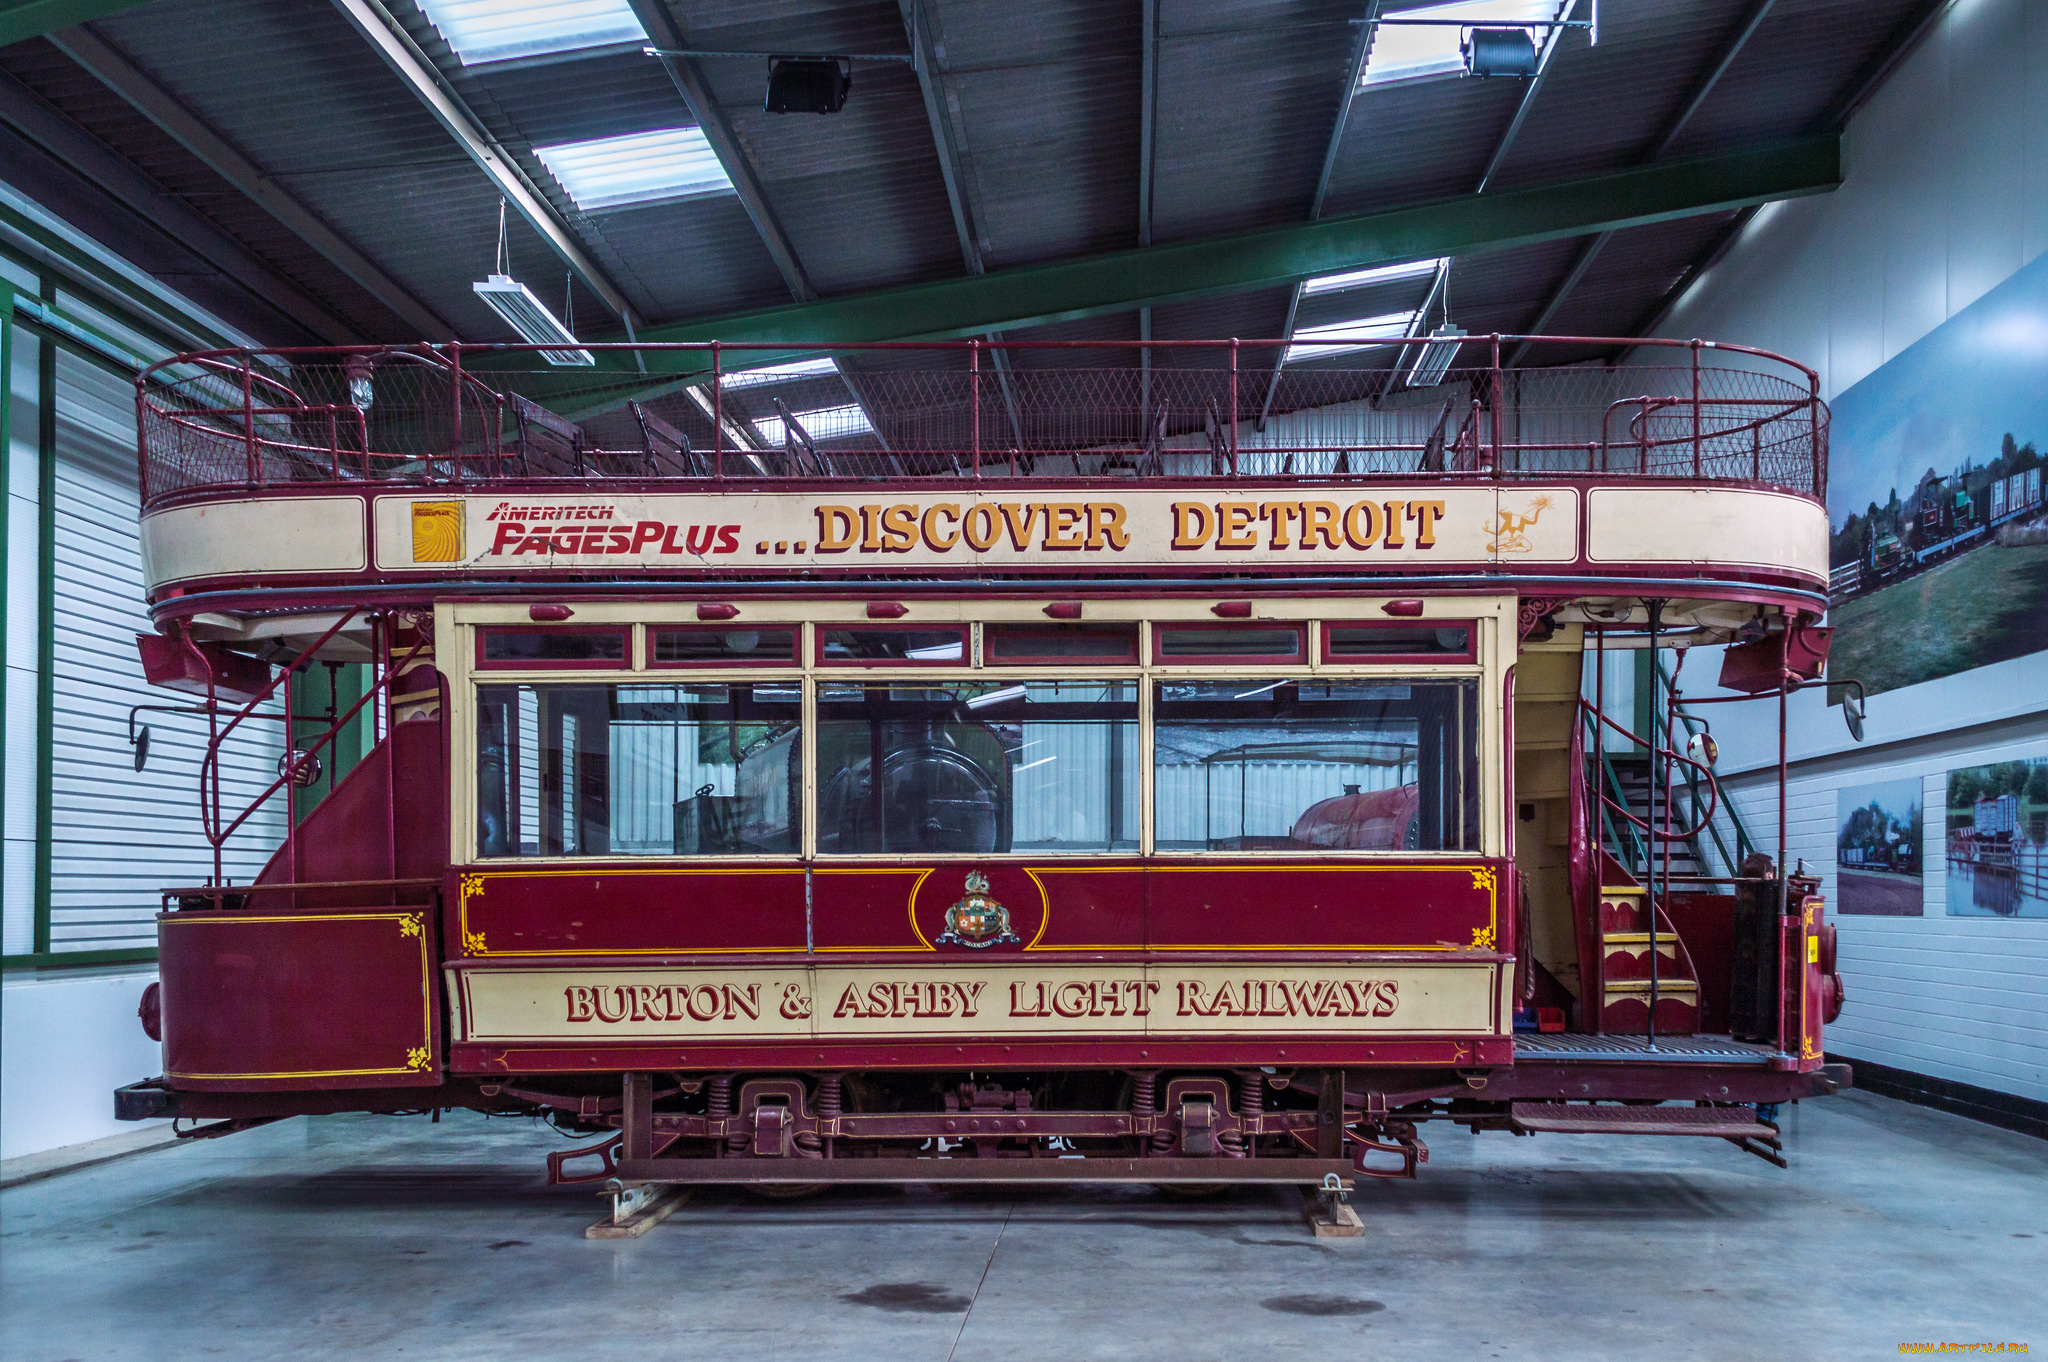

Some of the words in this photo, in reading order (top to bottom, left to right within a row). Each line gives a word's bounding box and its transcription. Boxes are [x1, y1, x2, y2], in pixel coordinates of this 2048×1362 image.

[485, 502, 615, 521] AMERITECH
[1170, 500, 1446, 551] DETROIT
[563, 982, 762, 1024] BURTON
[779, 983, 812, 1020] &
[833, 981, 989, 1018] ASHBY
[1008, 980, 1161, 1018] LIGHT
[1175, 980, 1400, 1018] RAILWAYS
